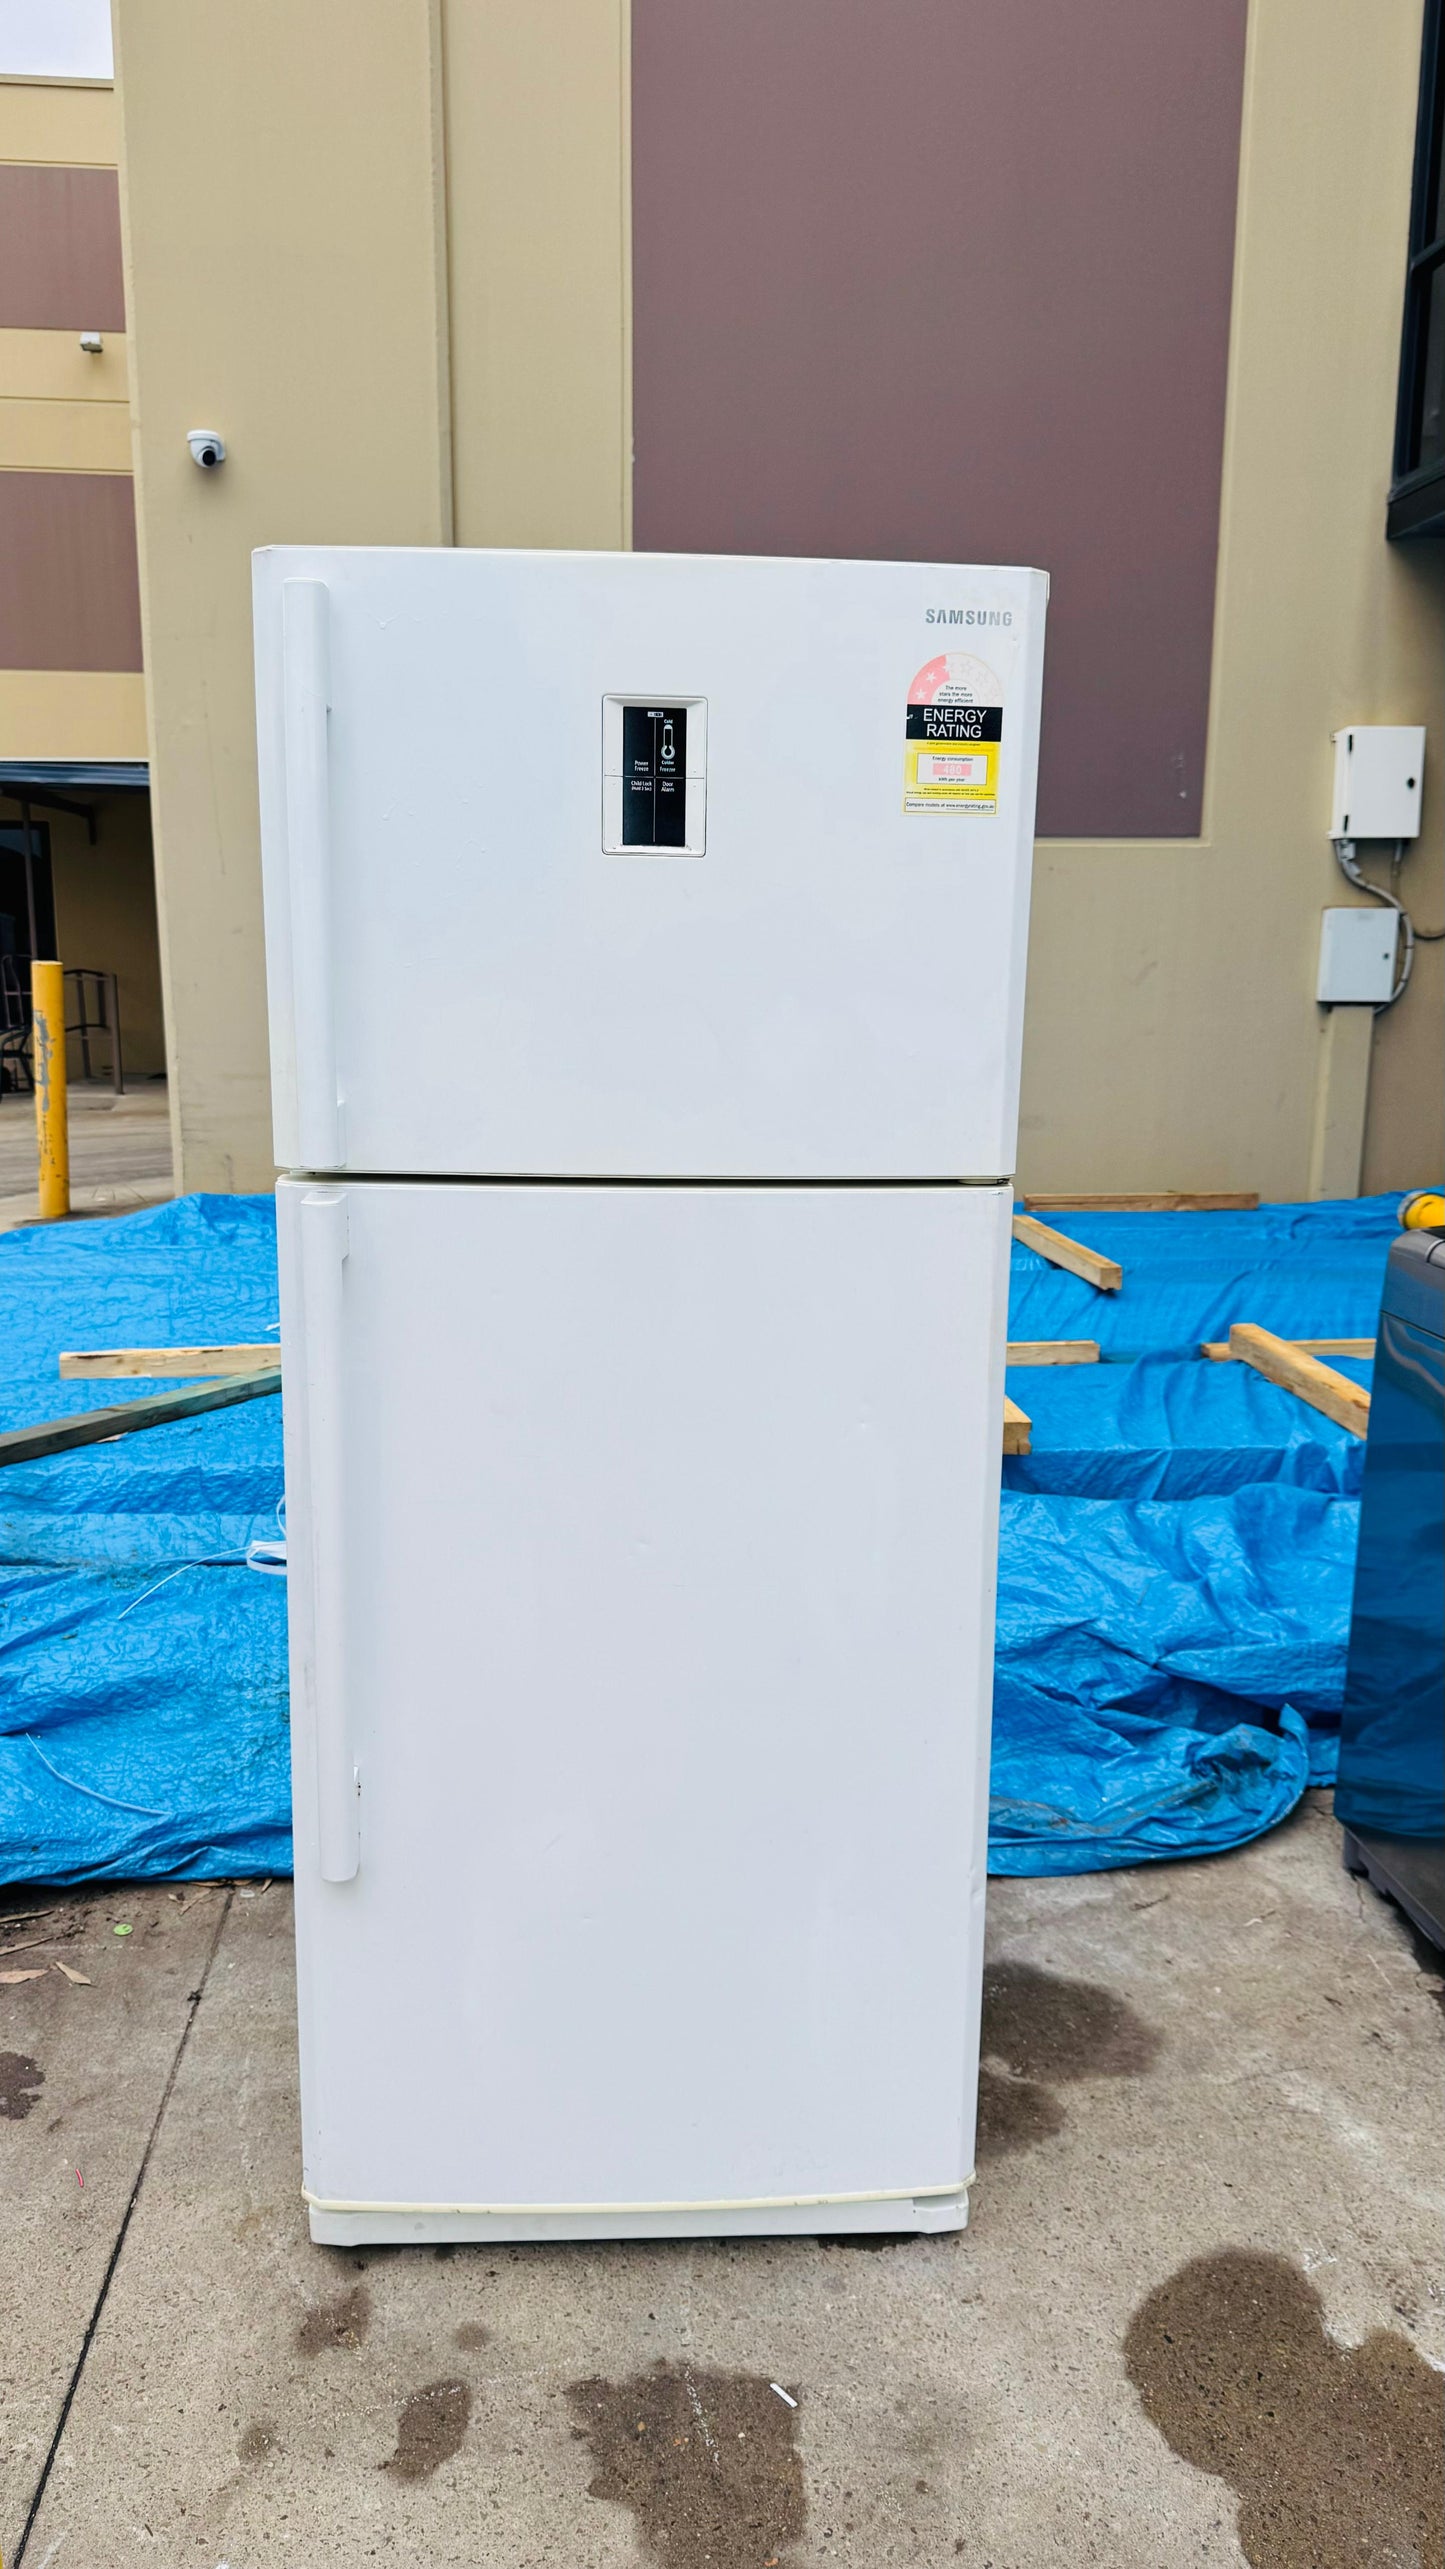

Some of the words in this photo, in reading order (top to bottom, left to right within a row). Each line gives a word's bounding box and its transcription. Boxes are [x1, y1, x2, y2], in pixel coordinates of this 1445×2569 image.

[925, 608, 1013, 627] SAMSUNG
[923, 708, 987, 723] ENERGY
[926, 723, 982, 738] RATING
